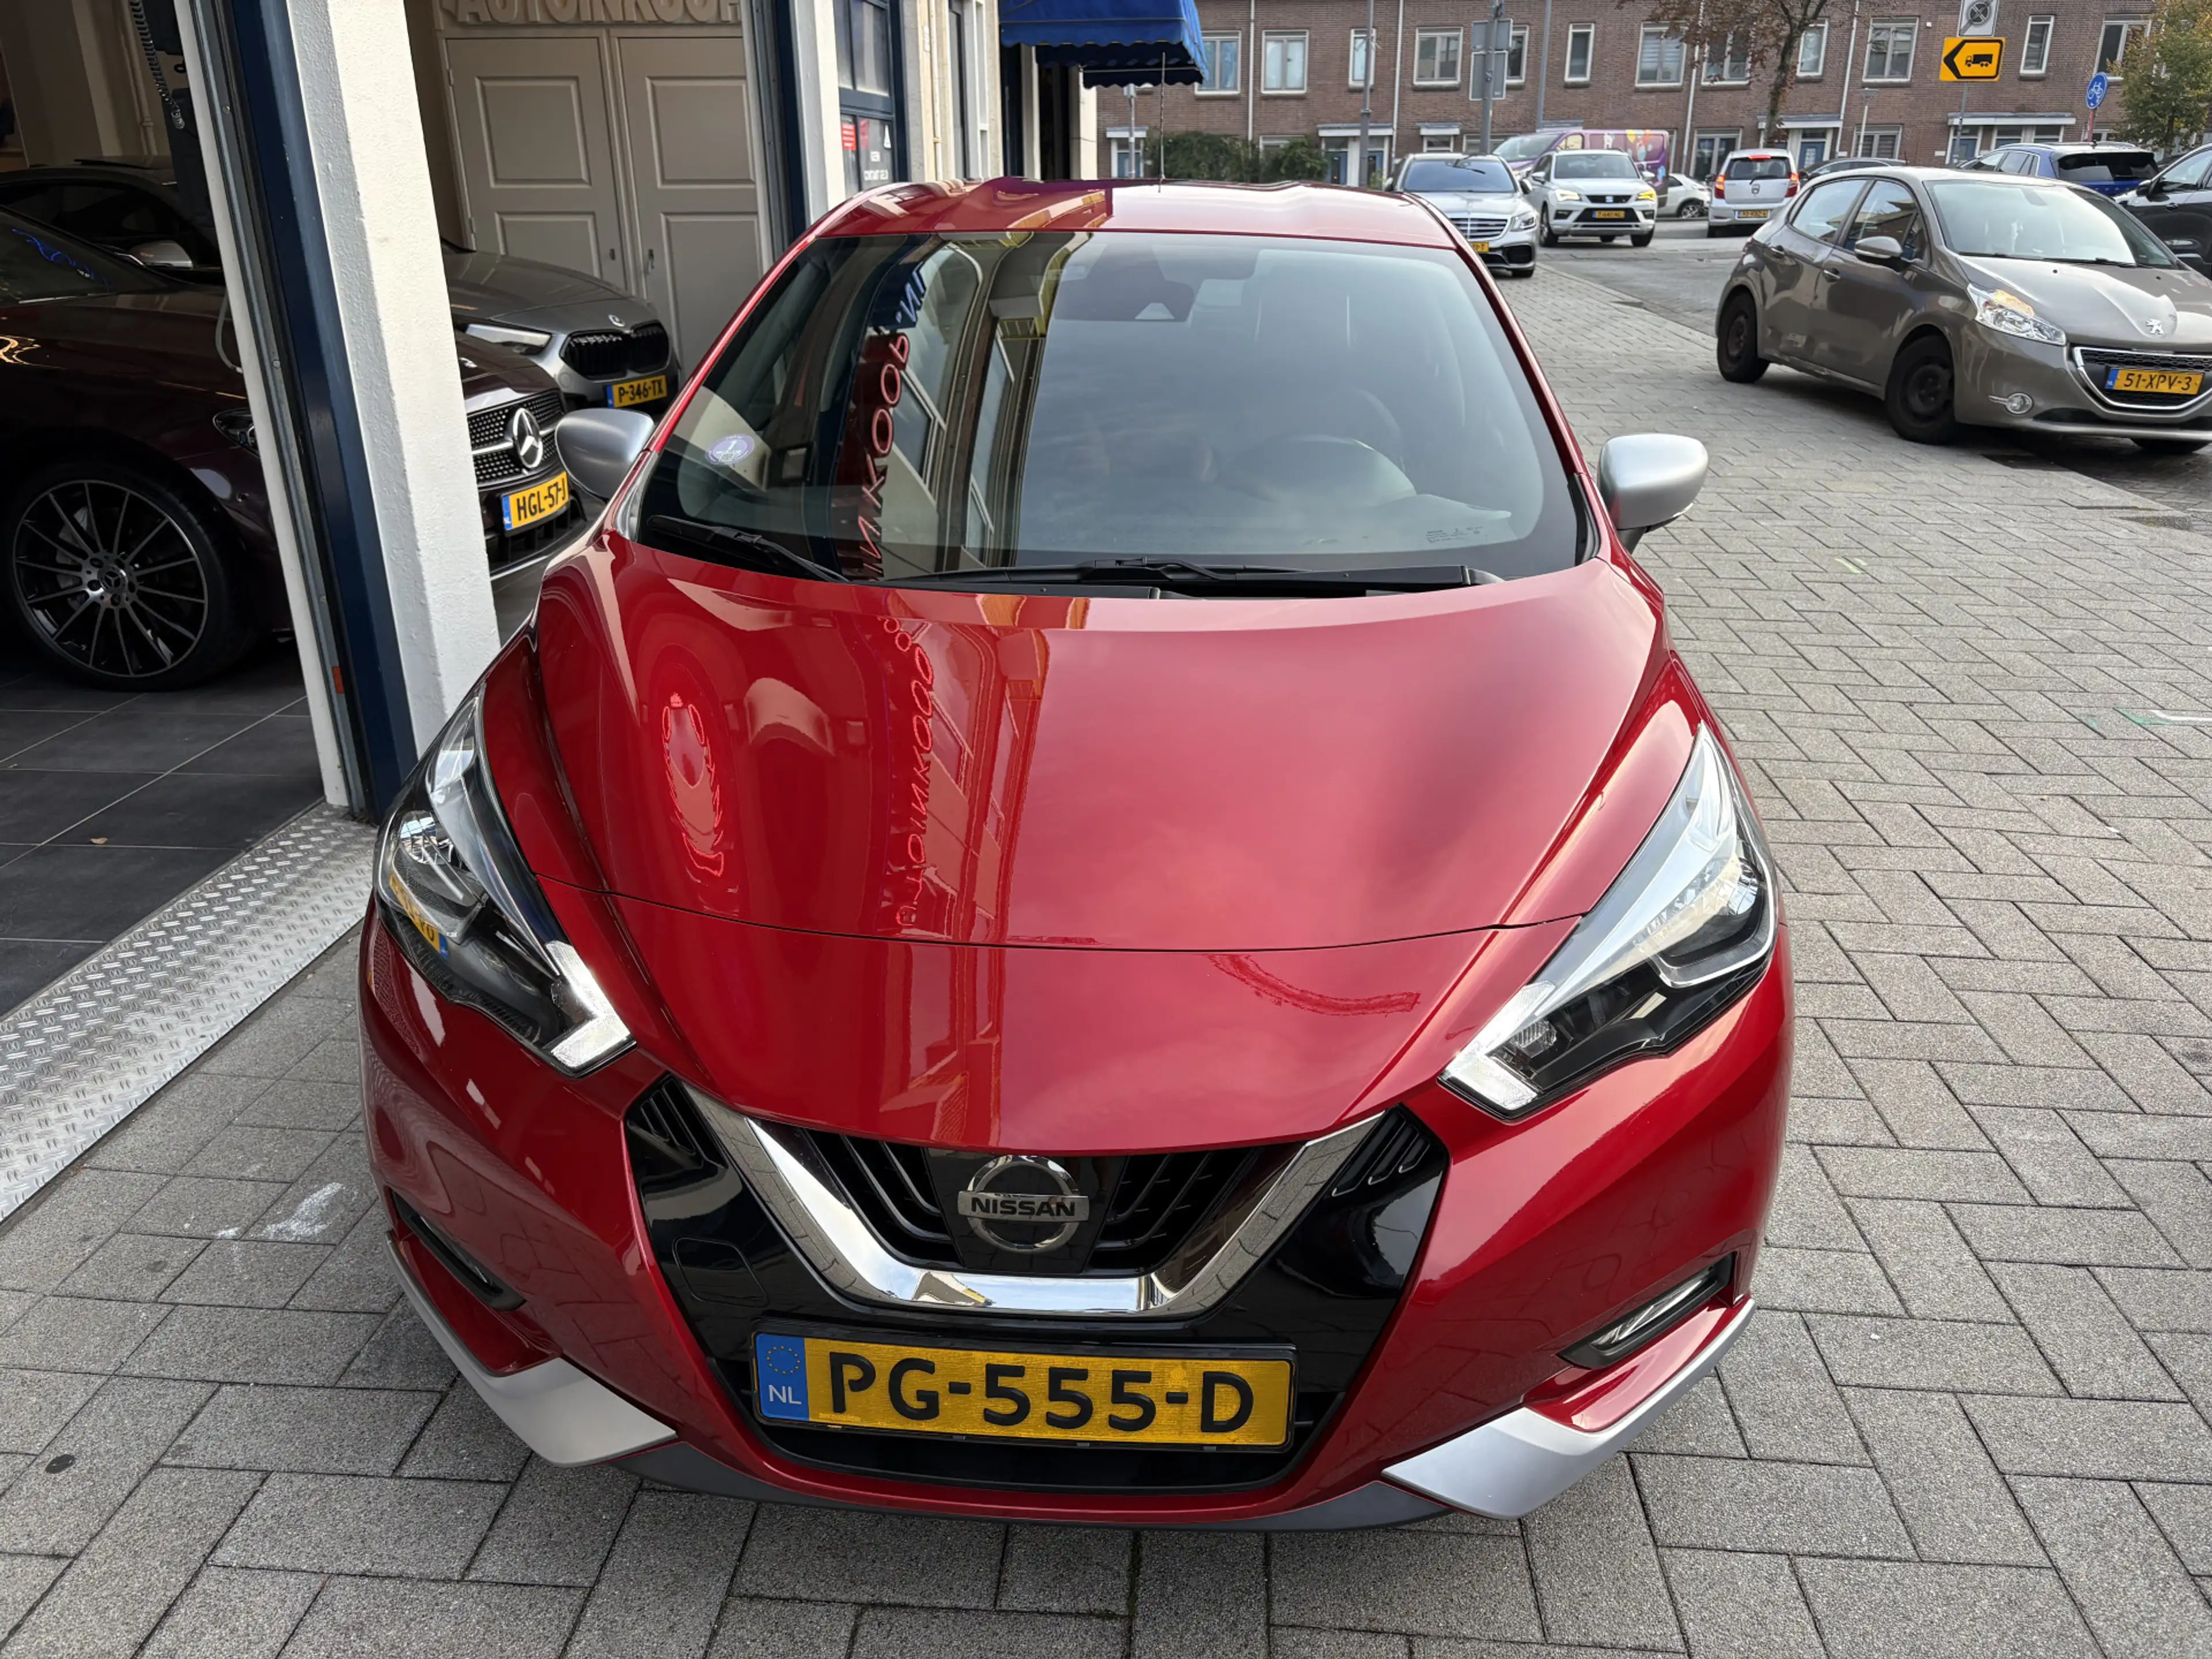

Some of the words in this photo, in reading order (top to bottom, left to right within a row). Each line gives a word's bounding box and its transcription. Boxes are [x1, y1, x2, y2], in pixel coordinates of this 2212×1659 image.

[618, 379, 664, 403] P-346-TX
[2123, 373, 2192, 391] 51-XPV-3
[516, 480, 567, 521] HGL-57-J
[971, 1196, 1075, 1217] NISSAN
[768, 1384, 802, 1405] NL
[828, 1351, 1255, 1434] PG-555-D
